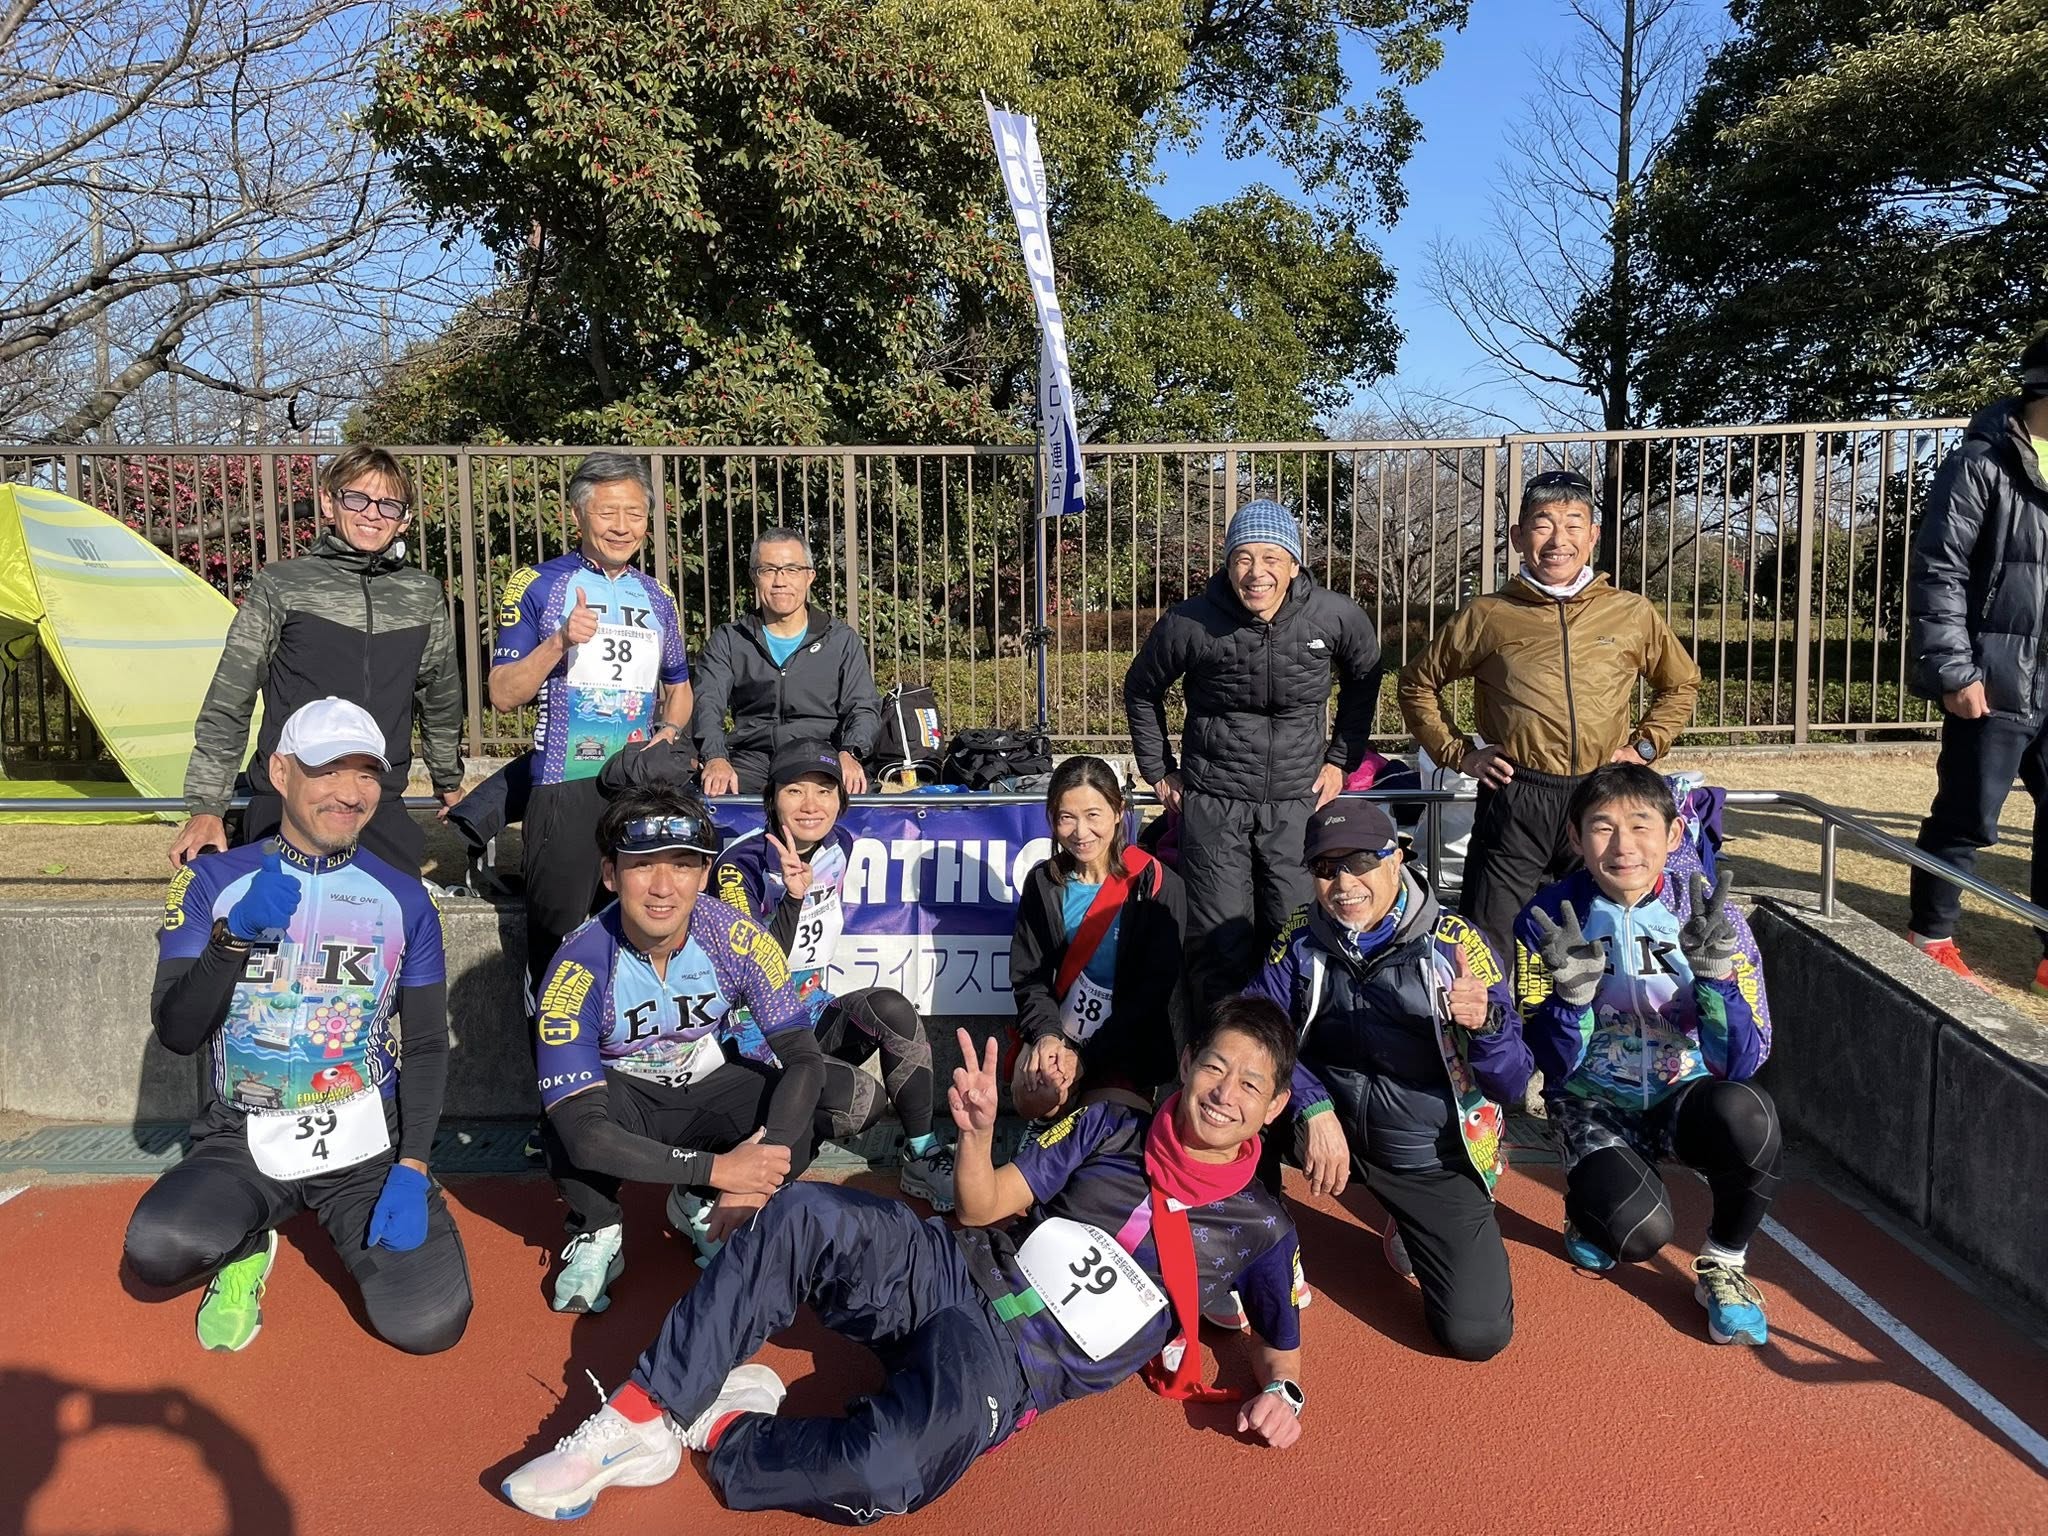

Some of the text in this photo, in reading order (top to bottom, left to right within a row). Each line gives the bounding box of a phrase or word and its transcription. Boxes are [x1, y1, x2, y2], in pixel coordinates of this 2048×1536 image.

[602, 637, 632, 663] 38
[611, 663, 623, 681] 2
[330, 893, 379, 904] WAVE ONE
[798, 919, 824, 949] 39
[805, 946, 816, 964] 2
[540, 959, 575, 1011] EDOGAWA
[564, 969, 595, 1016] TRIATHLON
[551, 984, 572, 1012] KOTO
[1073, 989, 1103, 1022] 38
[543, 1017, 572, 1041] EK
[1077, 1018, 1085, 1036] 1
[538, 1070, 593, 1091] TOKYO
[655, 1071, 693, 1089] 39
[295, 1110, 338, 1141] 39
[311, 1138, 330, 1161] 4
[1068, 1245, 1118, 1295] 39
[1061, 1282, 1082, 1306] 1
